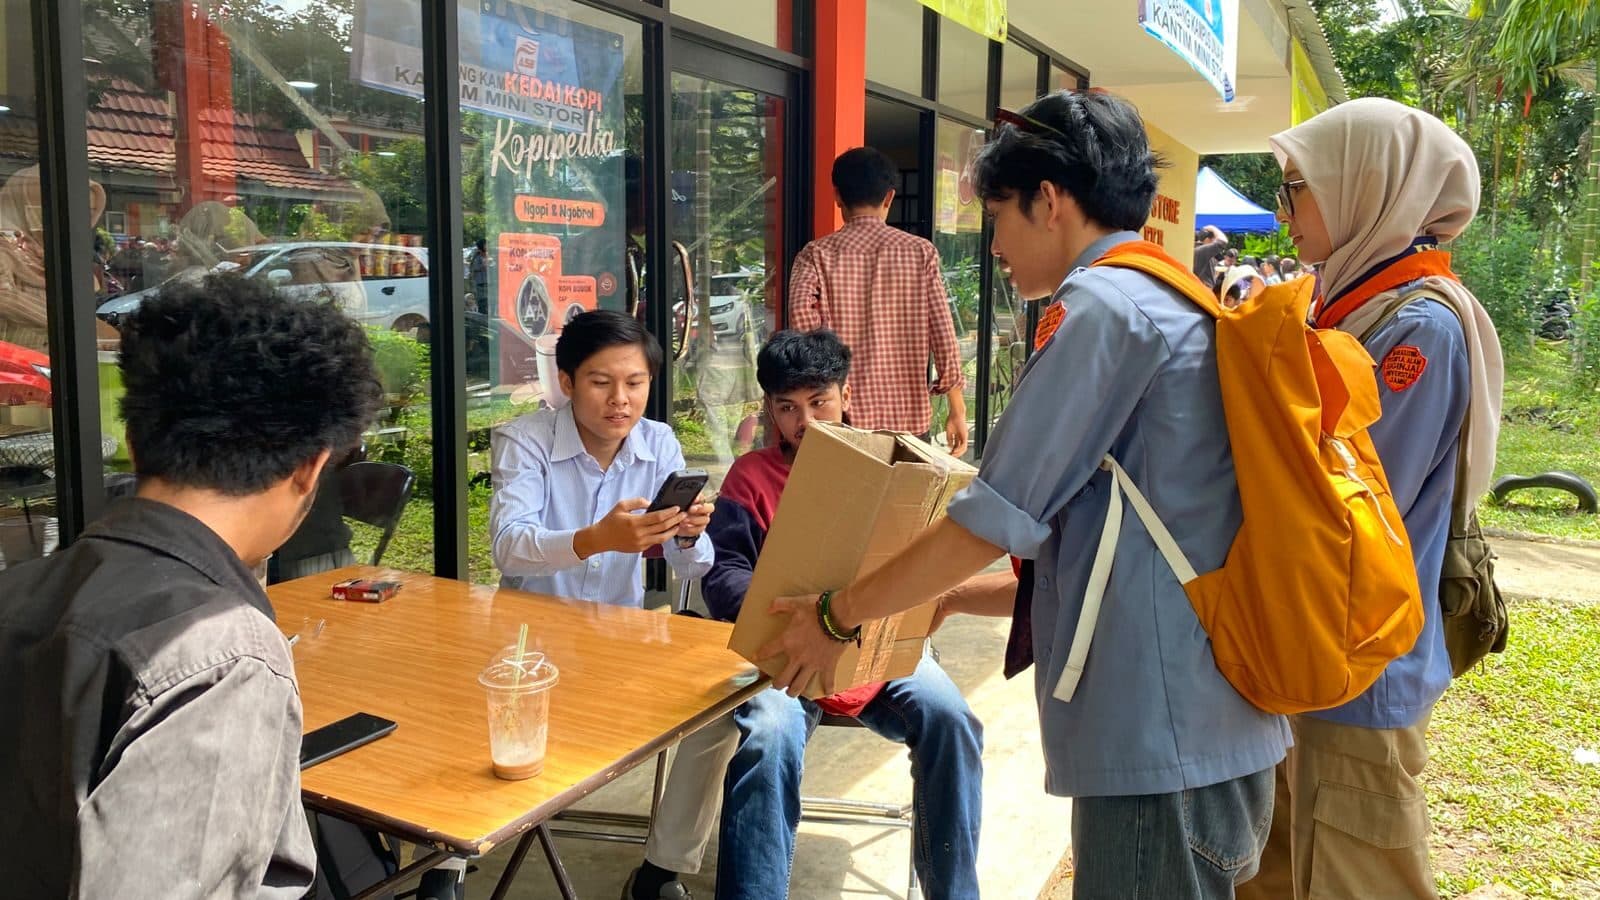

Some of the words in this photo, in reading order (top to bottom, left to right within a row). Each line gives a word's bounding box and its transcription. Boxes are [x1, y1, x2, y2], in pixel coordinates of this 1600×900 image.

[1153, 2, 1191, 51] KANTIM
[486, 89, 526, 113] MINI
[505, 72, 561, 104] KEDAI
[564, 84, 602, 113] KOPI
[490, 109, 617, 180] Kopipedia
[524, 202, 548, 219] Ngopi
[551, 204, 557, 216] &
[560, 204, 594, 220] Ngobrol
[1151, 194, 1180, 225] STORE
